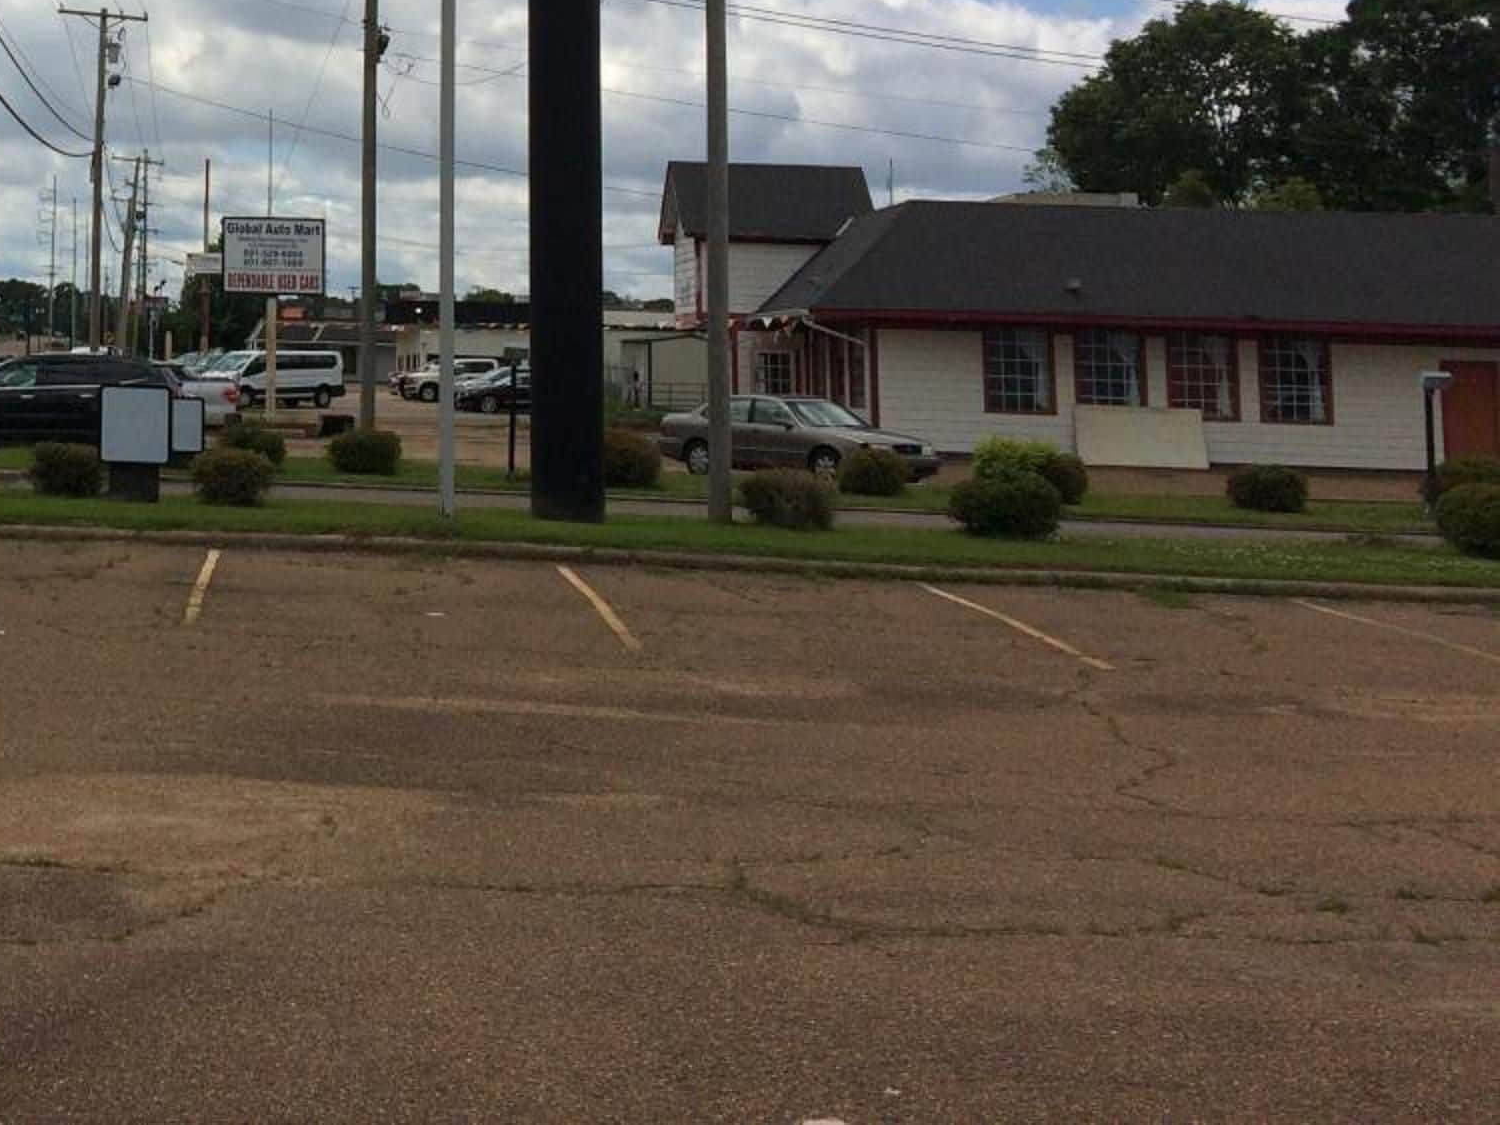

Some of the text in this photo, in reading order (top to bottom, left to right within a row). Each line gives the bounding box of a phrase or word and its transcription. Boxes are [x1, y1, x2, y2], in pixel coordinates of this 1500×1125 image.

[227, 222, 322, 236] Global Auto Mart
[227, 272, 320, 290] DEPENDABLE USED CARS
